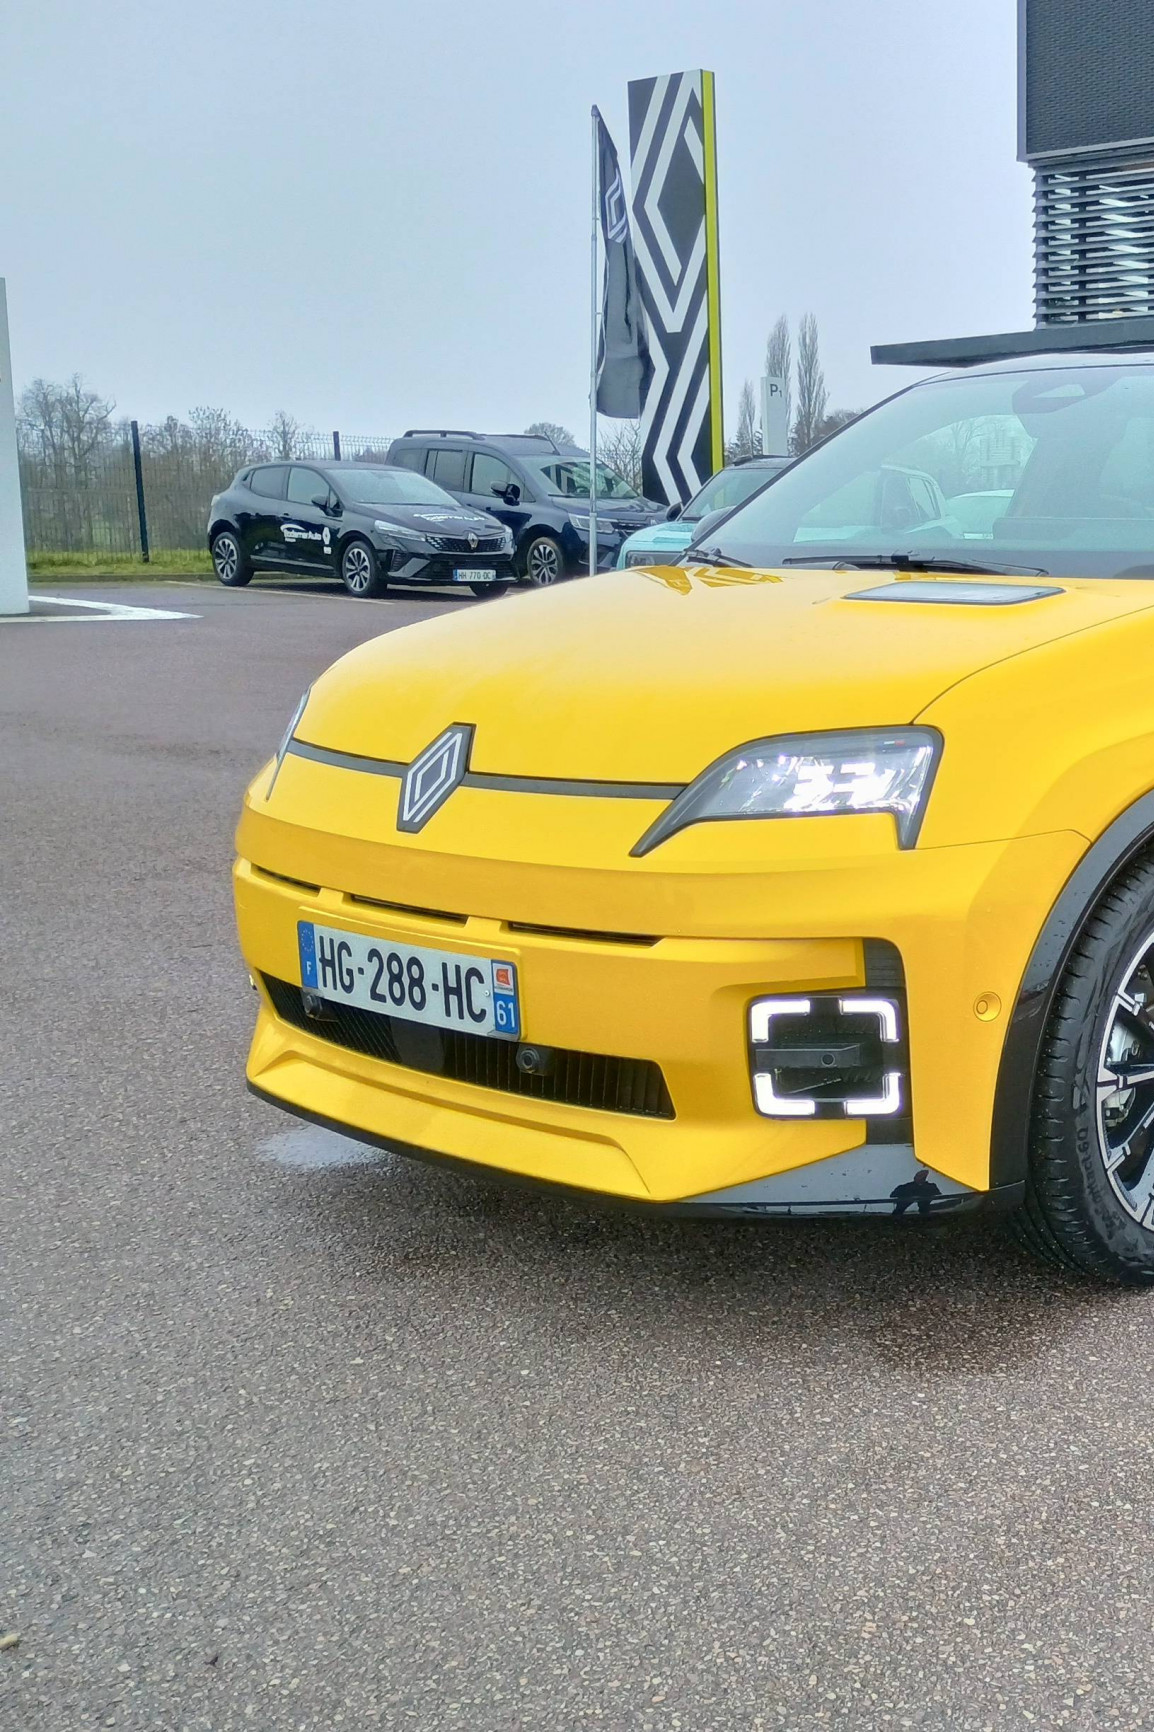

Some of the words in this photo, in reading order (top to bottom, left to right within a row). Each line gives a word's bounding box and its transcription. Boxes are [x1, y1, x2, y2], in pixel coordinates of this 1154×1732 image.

[306, 961, 312, 975] F
[318, 935, 487, 1023] HG-288-HC
[496, 1000, 515, 1028] 61
